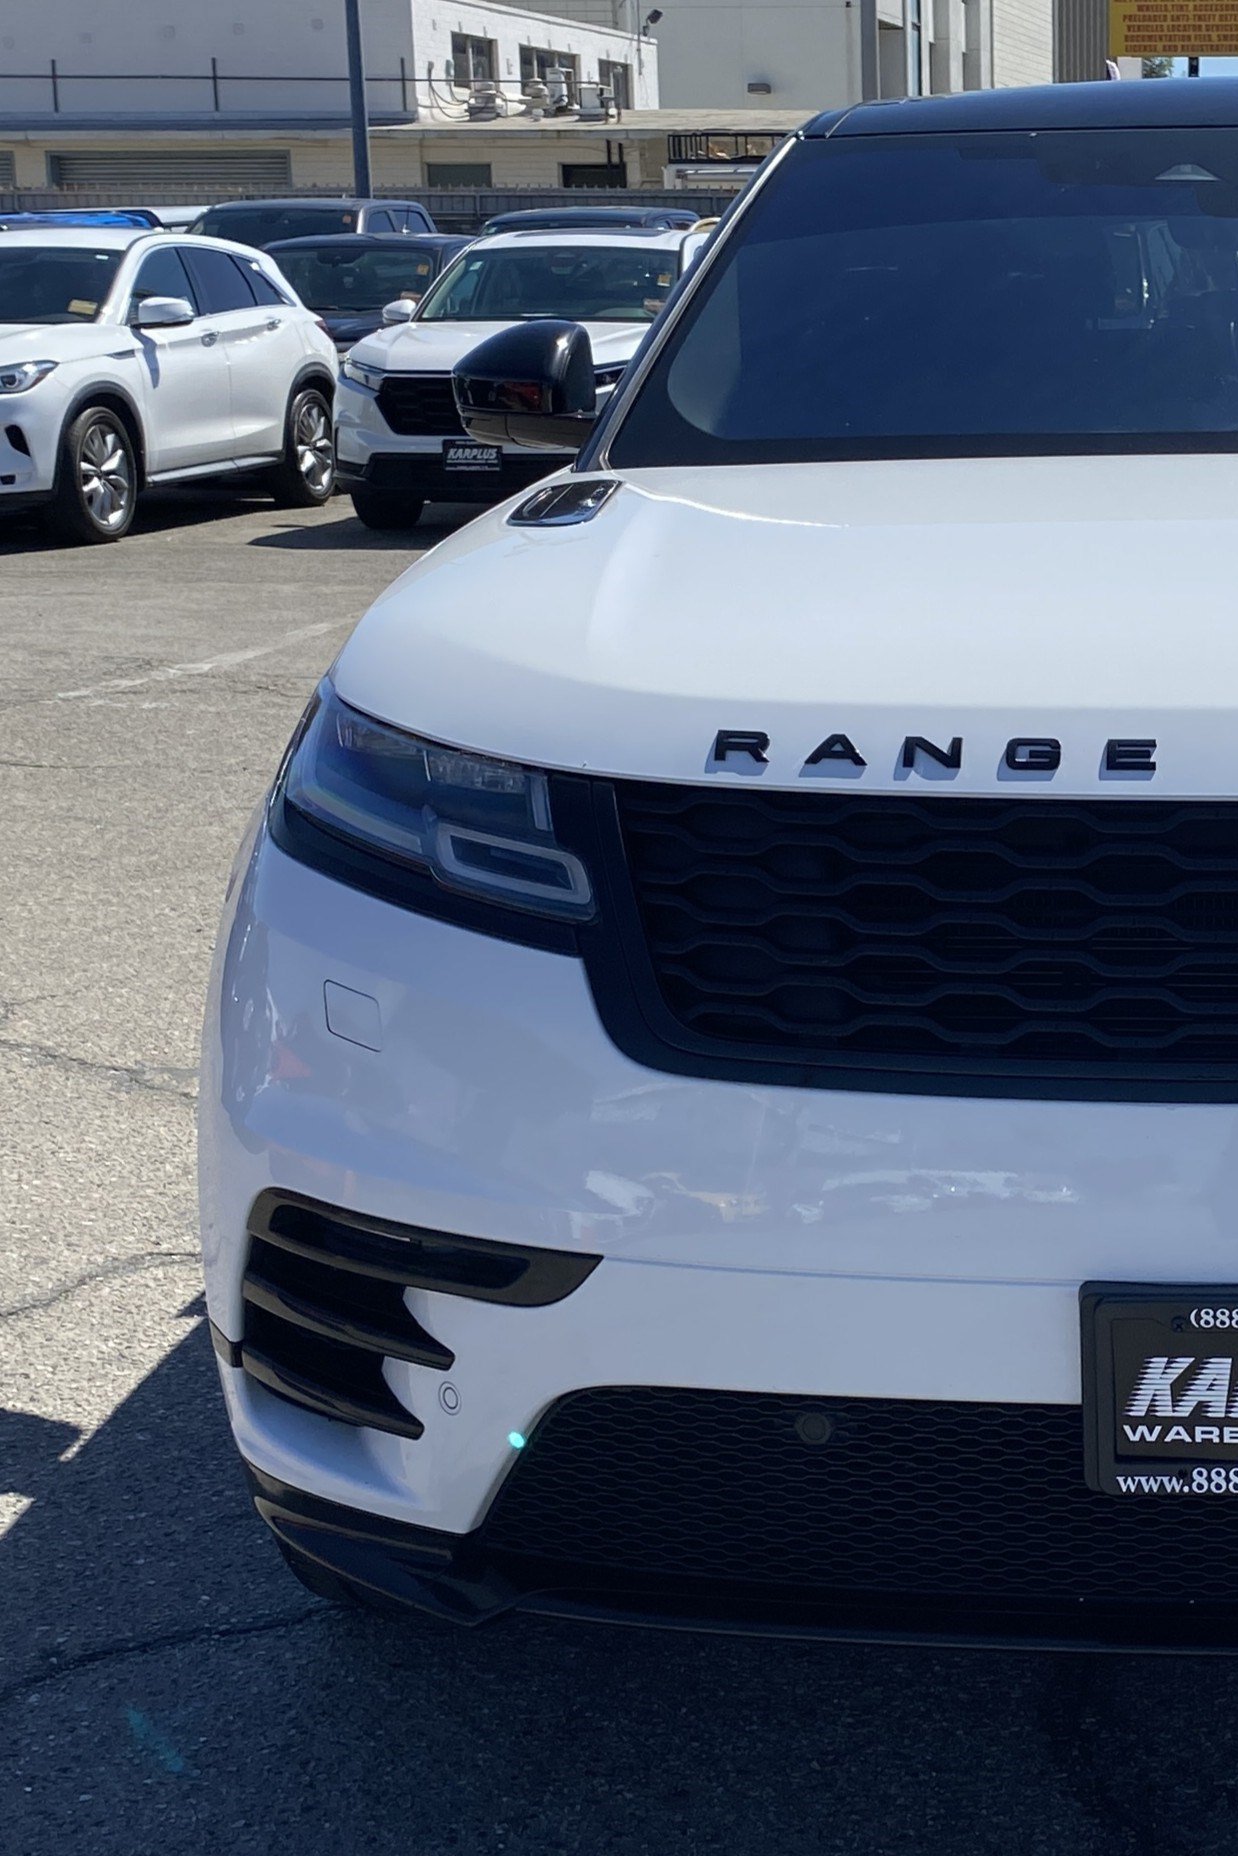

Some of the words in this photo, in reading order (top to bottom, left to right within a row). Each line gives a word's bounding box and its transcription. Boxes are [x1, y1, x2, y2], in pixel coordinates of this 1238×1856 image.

[1170, 14, 1218, 22] ANTI-THEFT
[1124, 34, 1192, 43] DOCUMENTATION
[1162, 44, 1179, 52] AND
[447, 448, 498, 459] KARPLUS
[714, 729, 1157, 772] RANGE
